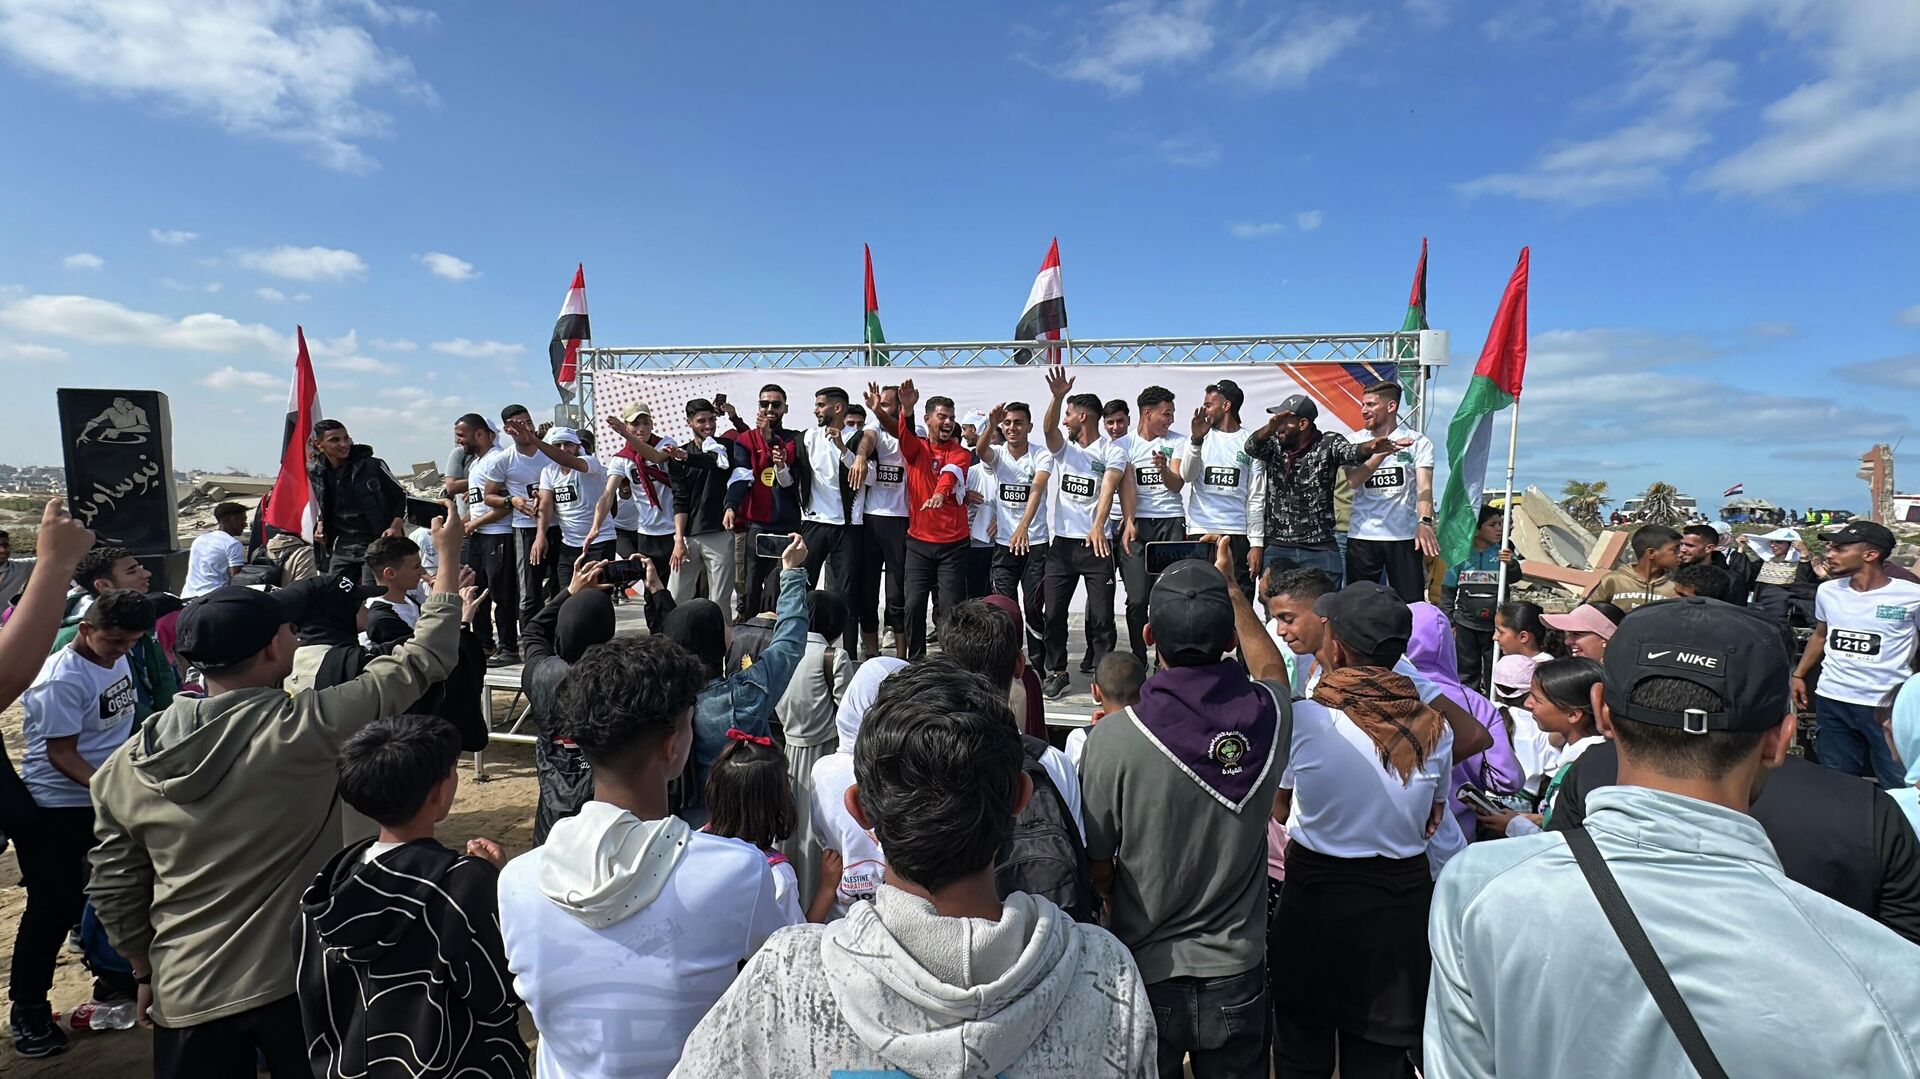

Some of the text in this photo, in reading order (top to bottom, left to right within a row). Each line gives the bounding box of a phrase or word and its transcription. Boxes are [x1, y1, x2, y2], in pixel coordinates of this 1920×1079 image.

[878, 471, 898, 481] 0838
[1210, 474, 1234, 485] 1145
[1371, 475, 1398, 486] 1033
[1066, 482, 1089, 495] 1099
[1004, 491, 1026, 501] 0890
[1835, 638, 1870, 652] 1219
[1676, 651, 1718, 669] NIKE
